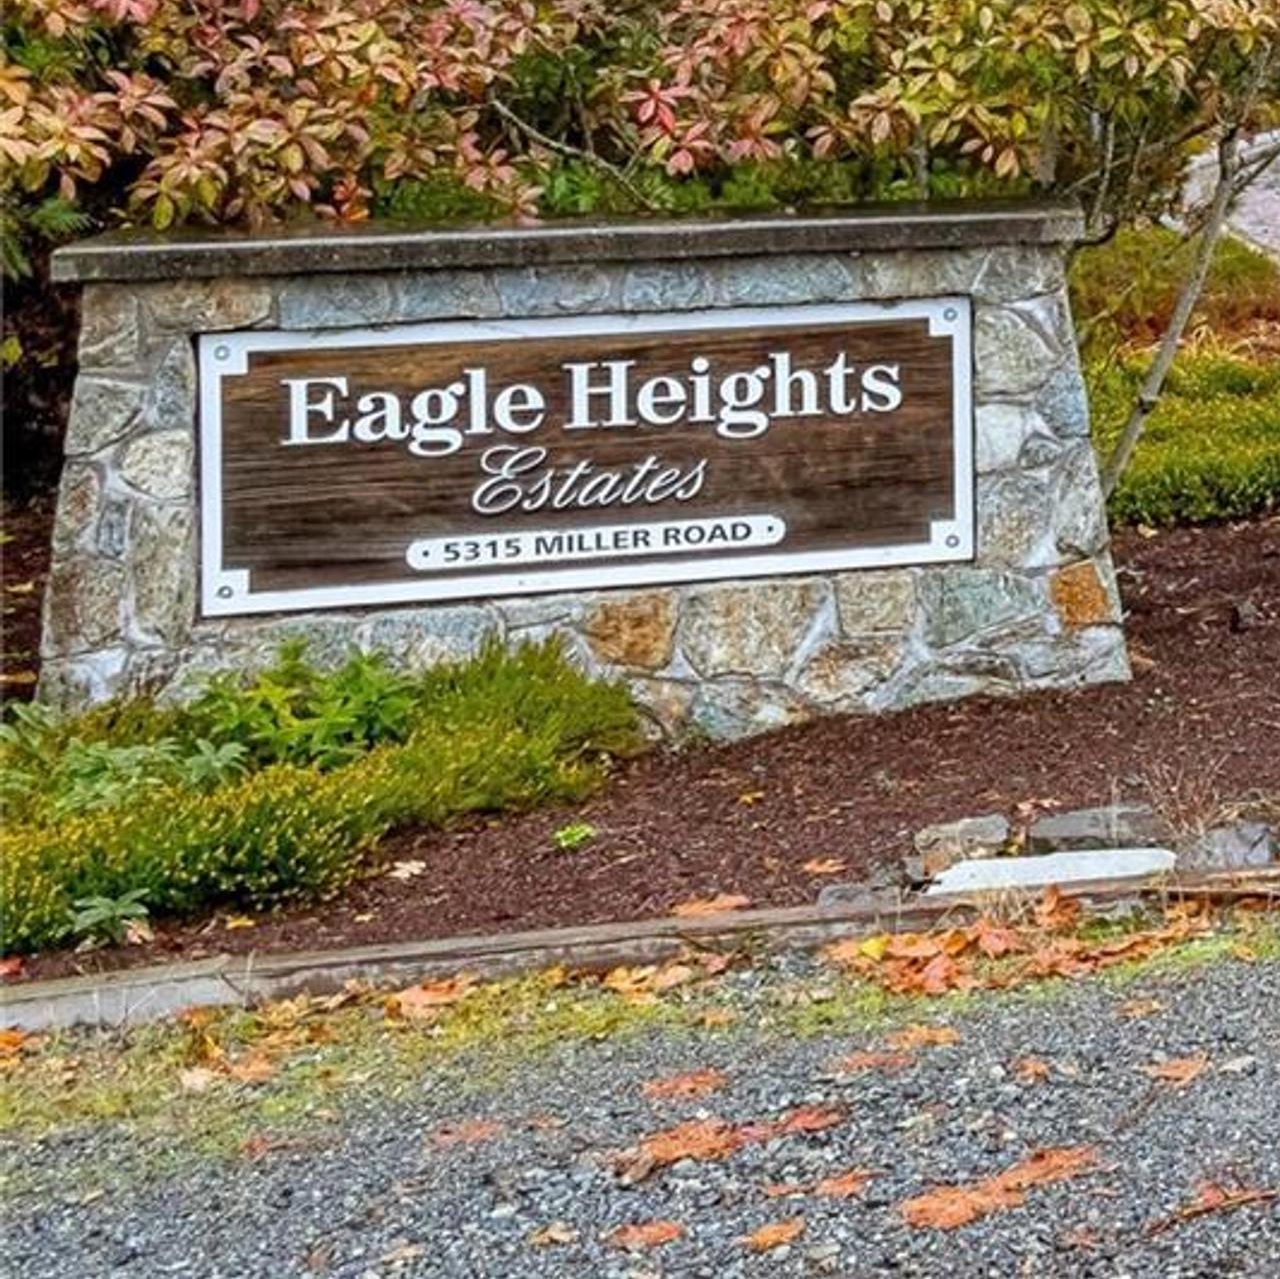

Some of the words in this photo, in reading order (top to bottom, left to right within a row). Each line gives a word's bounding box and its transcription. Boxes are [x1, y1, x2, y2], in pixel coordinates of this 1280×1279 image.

[281, 368, 546, 455] Eagle
[562, 349, 904, 438] Heights
[472, 445, 709, 514] Estates
[443, 538, 521, 562] 5315
[534, 530, 651, 556] MILLER
[662, 522, 752, 546] ROAD
